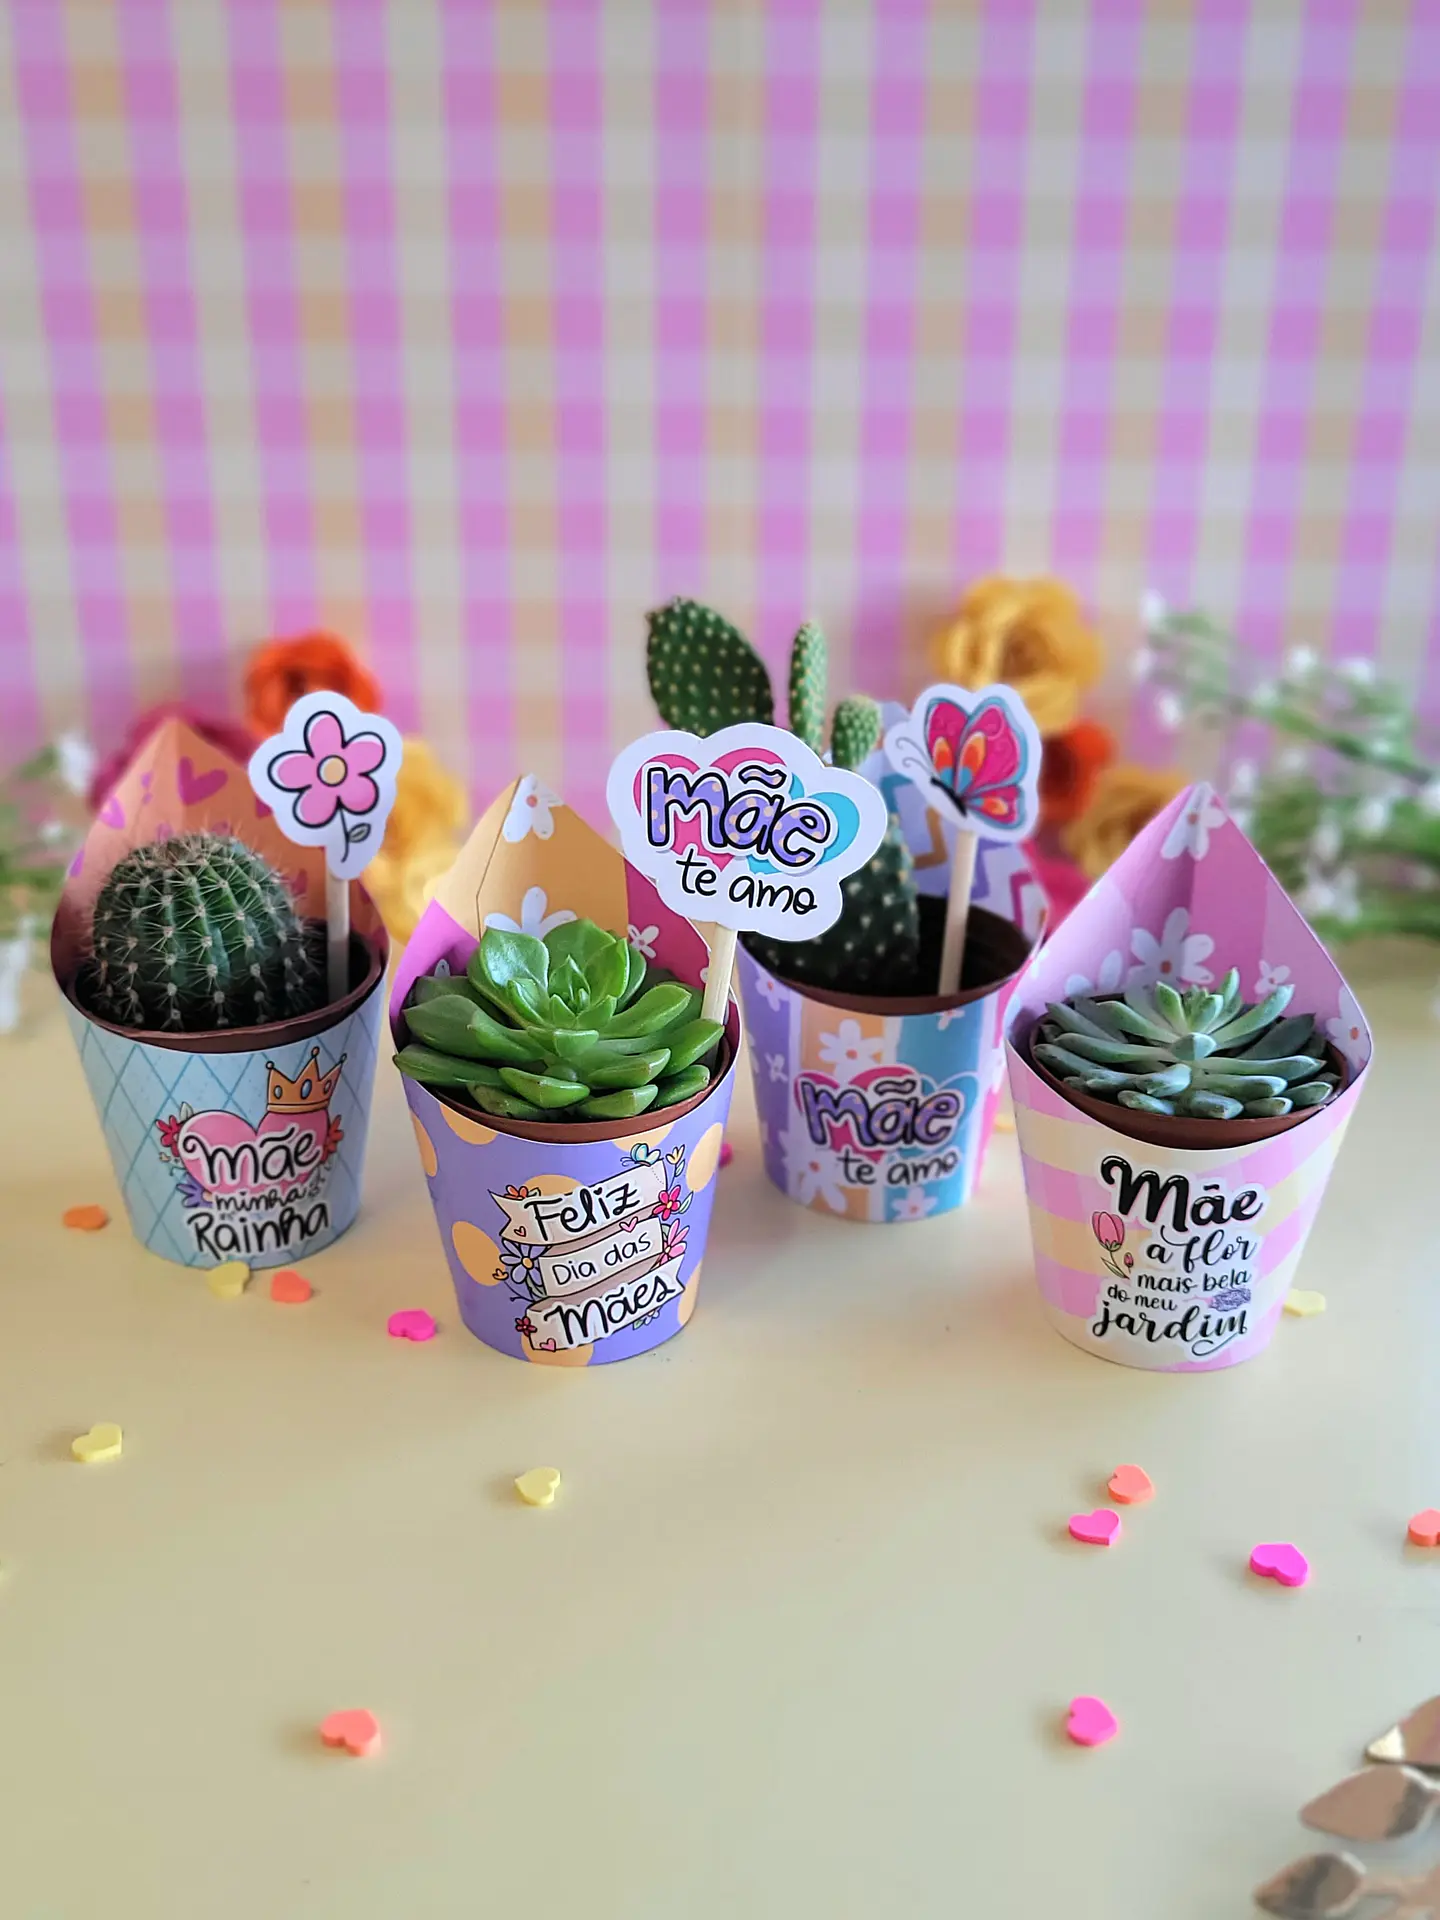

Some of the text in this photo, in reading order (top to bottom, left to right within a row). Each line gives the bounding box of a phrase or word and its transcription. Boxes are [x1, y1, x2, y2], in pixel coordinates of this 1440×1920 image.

[676, 849, 817, 914] te amo
[836, 1148, 958, 1185] te amo
[1100, 1156, 1263, 1232] Mãe
[215, 1188, 303, 1211] minha
[523, 1183, 640, 1241] Feliz
[187, 1203, 328, 1260] Rainha
[552, 1231, 651, 1286] Dia das
[1146, 1225, 1256, 1273] a flor
[1107, 1284, 1178, 1311] do meu
[1137, 1268, 1252, 1294] mais bela
[543, 1275, 676, 1345] Mães
[1092, 1301, 1248, 1356] jardim
